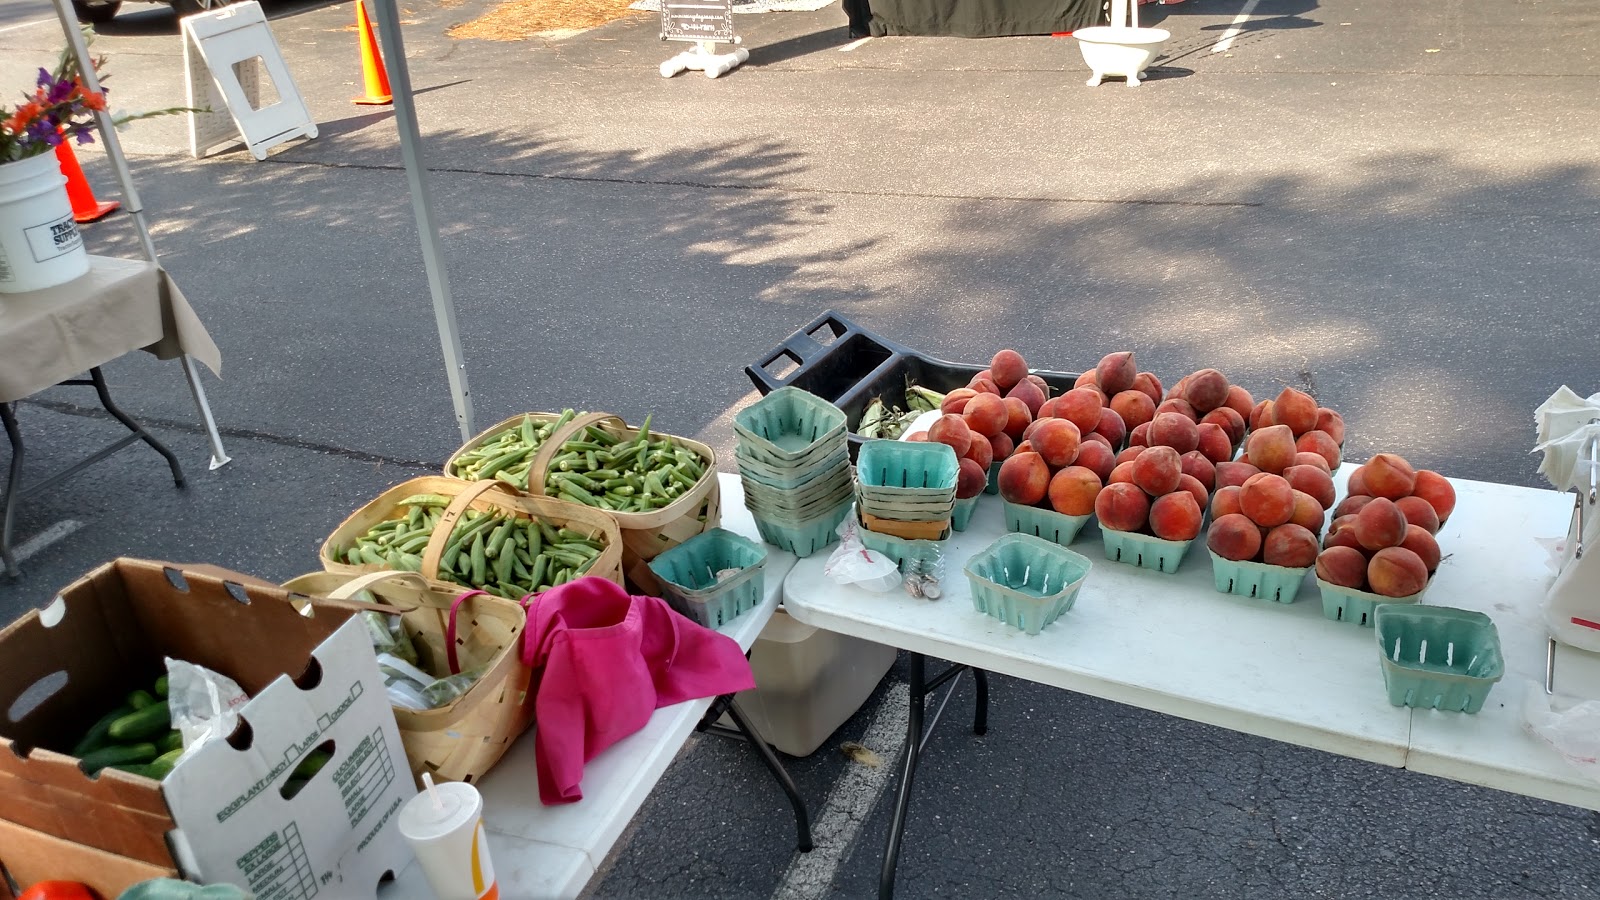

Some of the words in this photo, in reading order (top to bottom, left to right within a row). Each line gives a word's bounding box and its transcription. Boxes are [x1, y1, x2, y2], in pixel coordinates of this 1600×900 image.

[217, 778, 265, 821] EGGPLANT
[265, 759, 287, 784] FANCY
[298, 731, 319, 755] LARGE
[330, 696, 353, 721] CHOICE
[332, 735, 371, 783] CUCUMBERS
[341, 771, 362, 797] SELECT
[345, 786, 363, 808] SMALL
[237, 831, 278, 868] PEPPERS
[357, 822, 383, 853] PRODUCE
[244, 861, 258, 875] EX
[256, 840, 281, 864] LARGE
[248, 860, 275, 884] LARGE
[252, 866, 284, 893] MEDIUM
